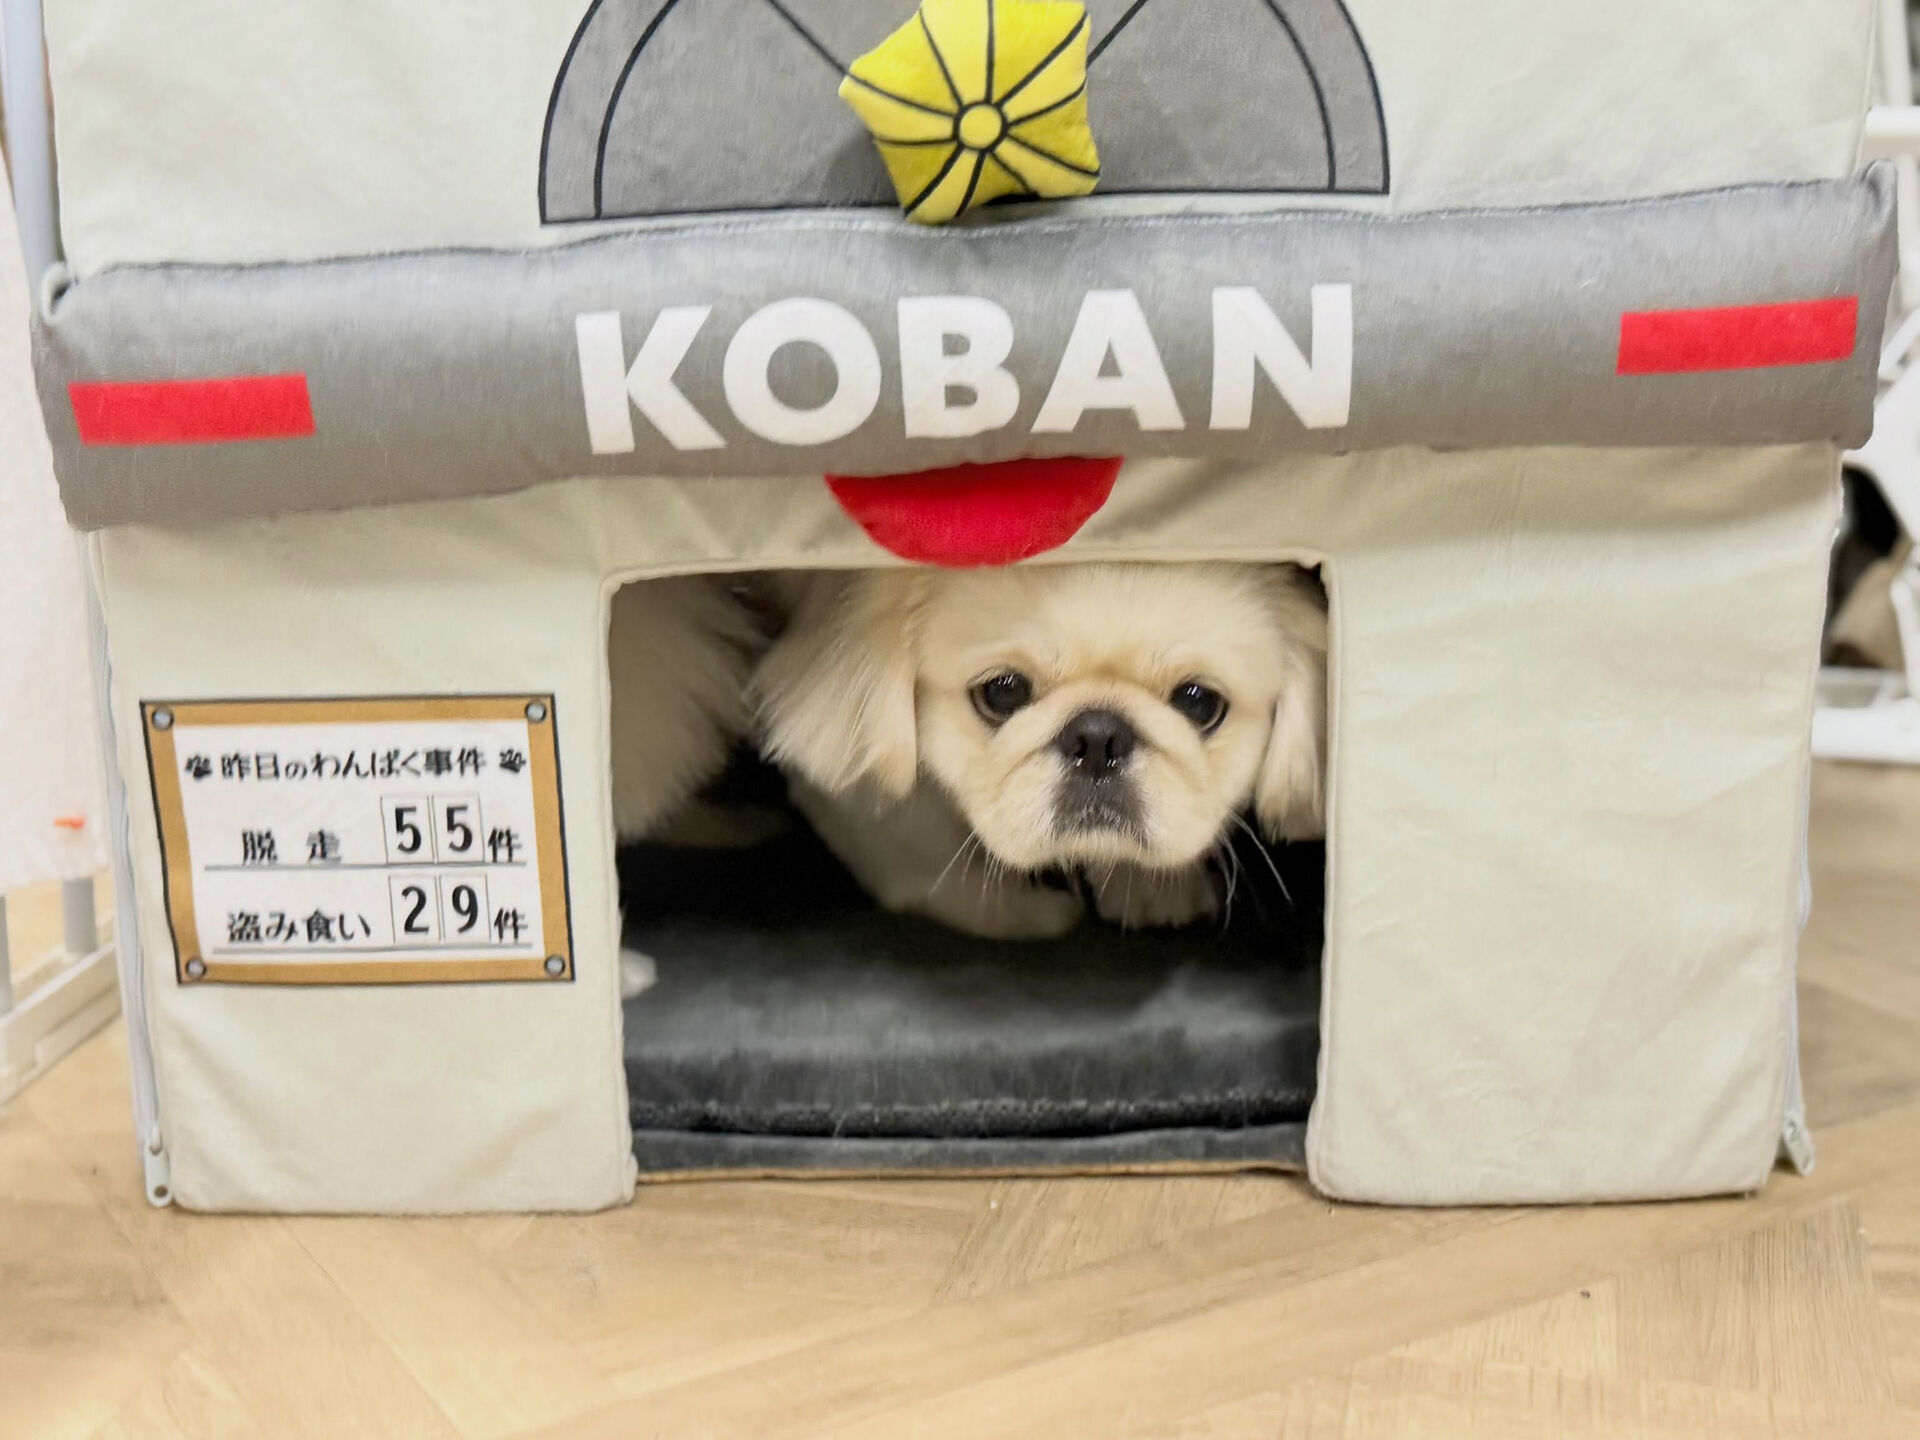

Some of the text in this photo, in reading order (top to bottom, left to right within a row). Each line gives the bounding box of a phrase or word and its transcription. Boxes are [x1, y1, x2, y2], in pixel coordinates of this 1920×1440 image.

[575, 283, 1353, 455] KOBAN
[227, 908, 371, 944] 盗み食い
